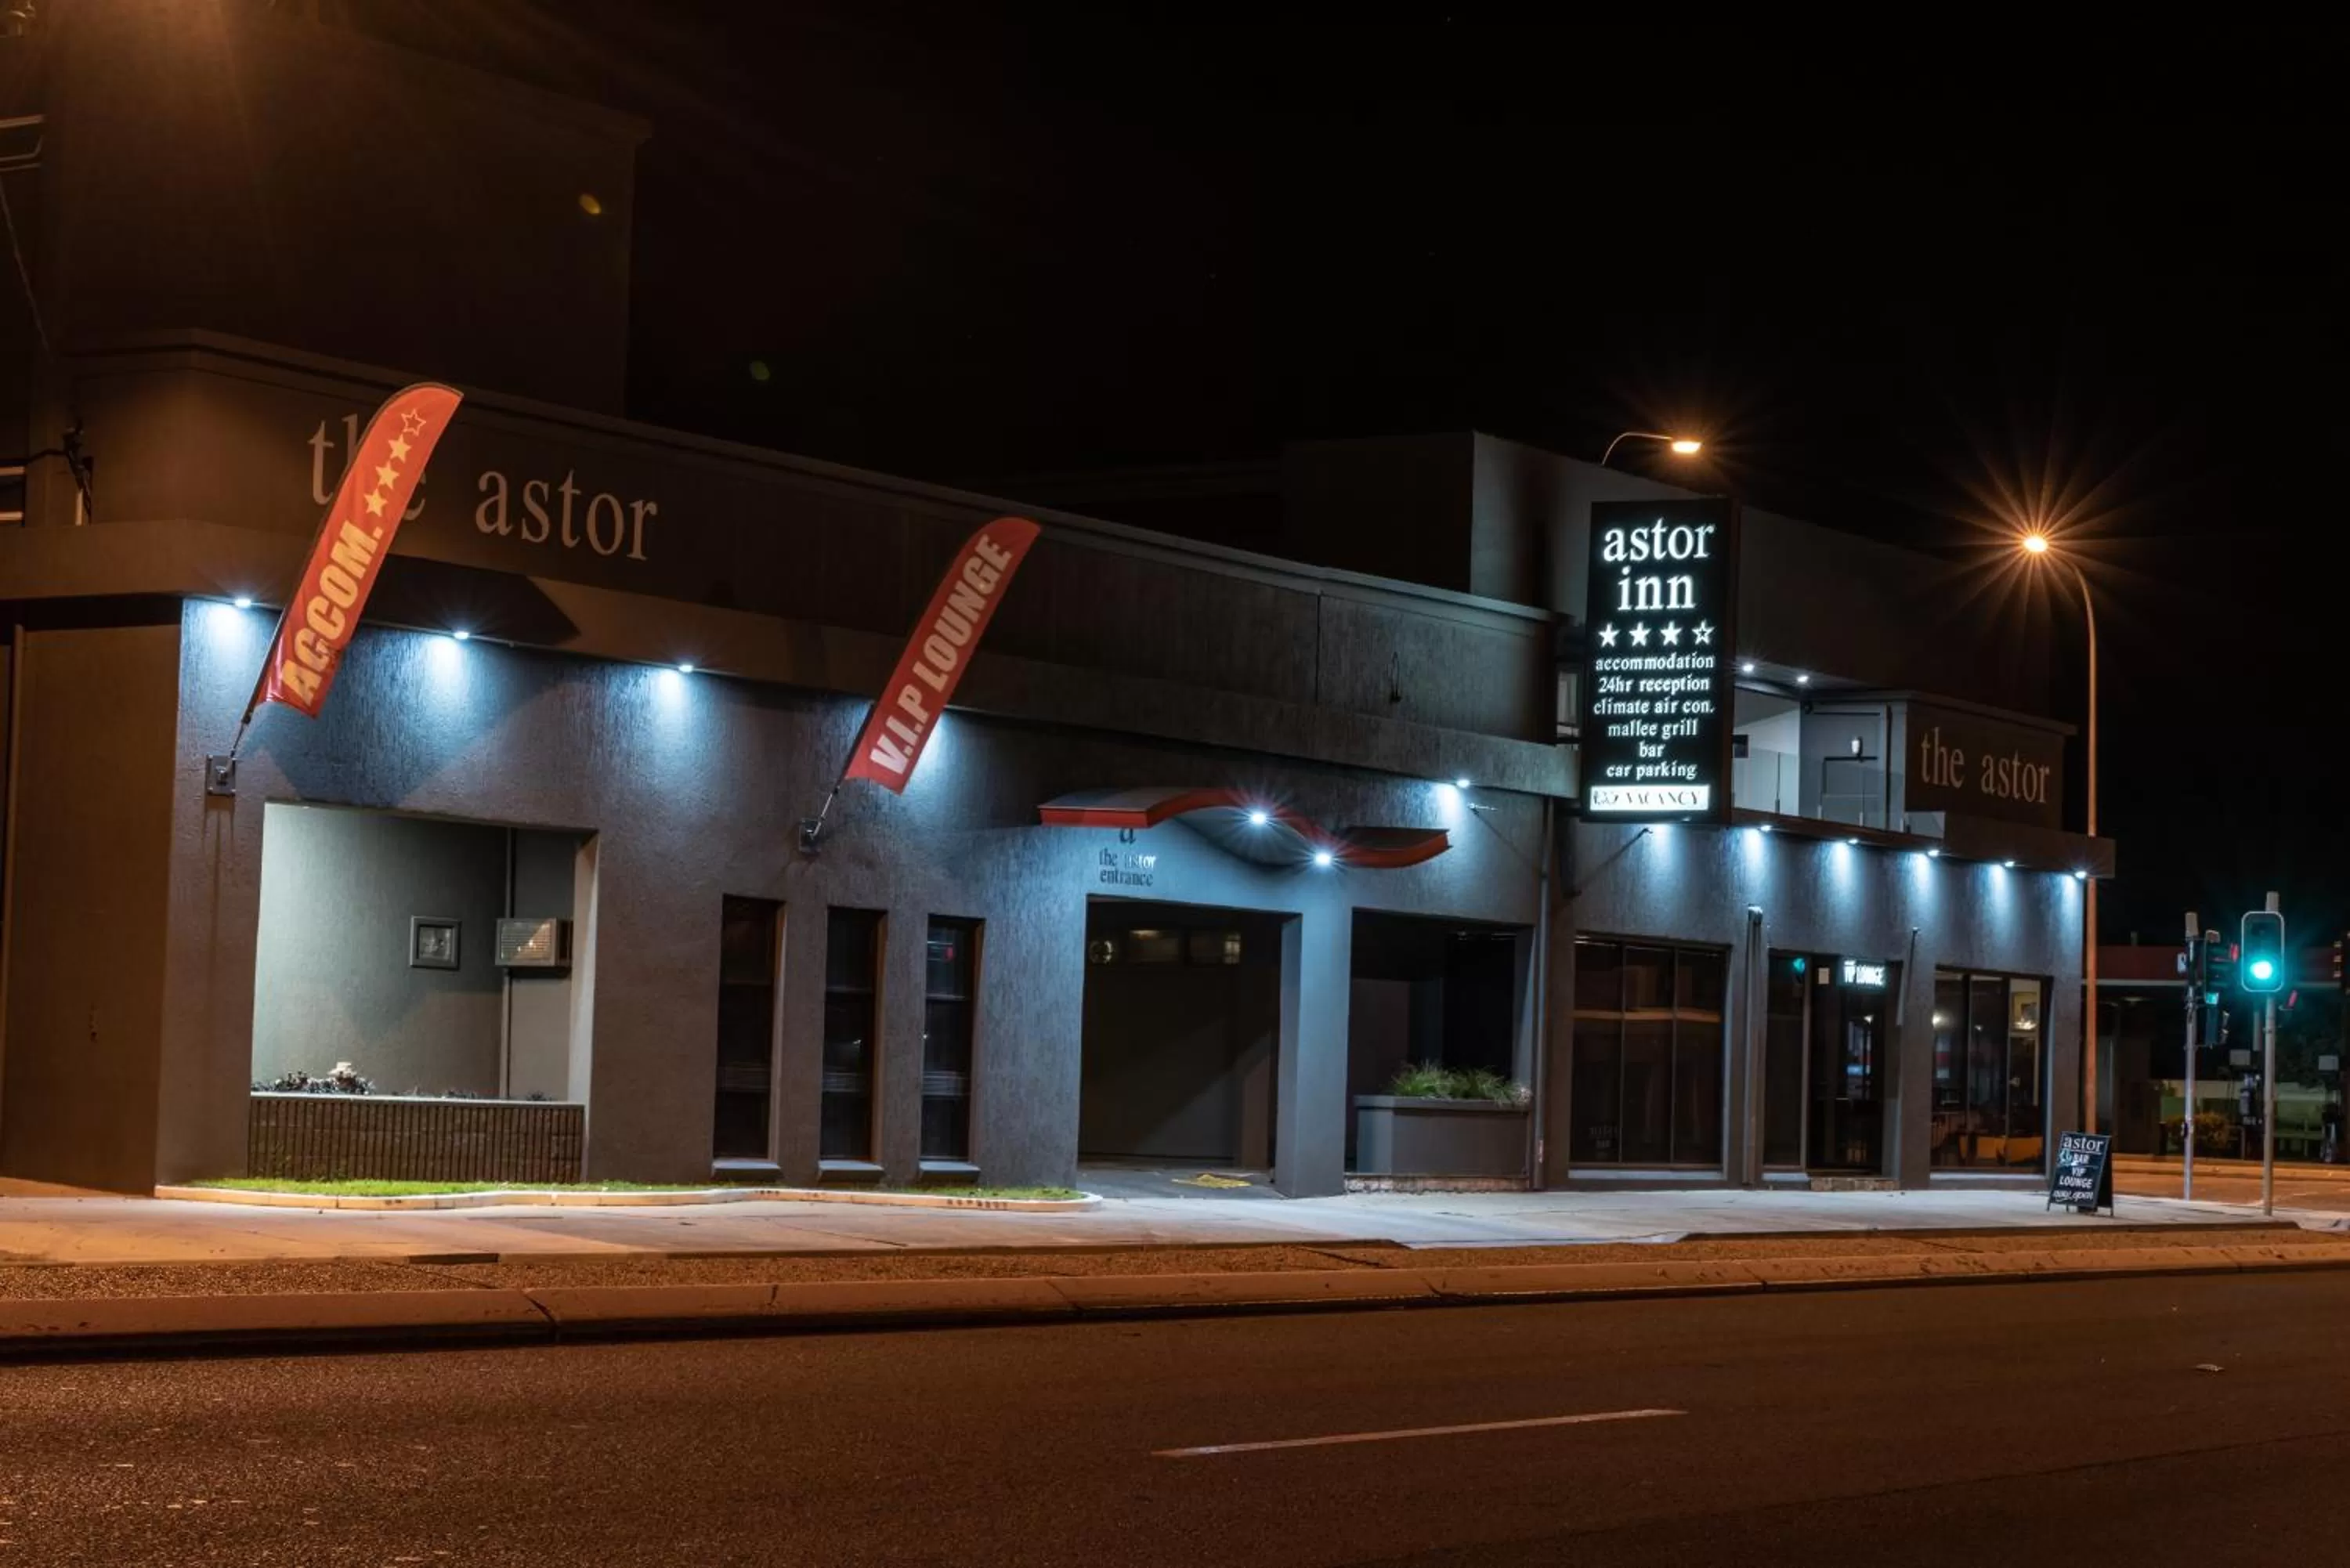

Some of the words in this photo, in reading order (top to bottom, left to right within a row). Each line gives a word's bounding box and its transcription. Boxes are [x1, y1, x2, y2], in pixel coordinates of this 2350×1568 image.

[475, 468, 658, 561] astor
[1603, 517, 1716, 562] astor
[1617, 565, 1697, 611] inn
[282, 520, 383, 706] ACCOM.
[870, 684, 930, 774] V.I.P
[913, 533, 1013, 692] LOUNGE
[1595, 652, 1715, 671] accommodation
[1598, 675, 1634, 693] 24hr
[1638, 674, 1710, 695] reception
[1593, 697, 1650, 715] climate
[1654, 695, 1679, 714] air
[1682, 700, 1716, 714] con.
[1607, 719, 1658, 737] mallee
[1661, 718, 1698, 740] grill
[1639, 741, 1666, 757] bar
[1606, 764, 1633, 777] car
[1635, 760, 1698, 781] parking
[1922, 726, 1965, 788] the
[1981, 749, 2050, 804] astor
[1099, 847, 1118, 866] the
[1100, 869, 1154, 887] entrance
[2063, 1136, 2104, 1153] astor
